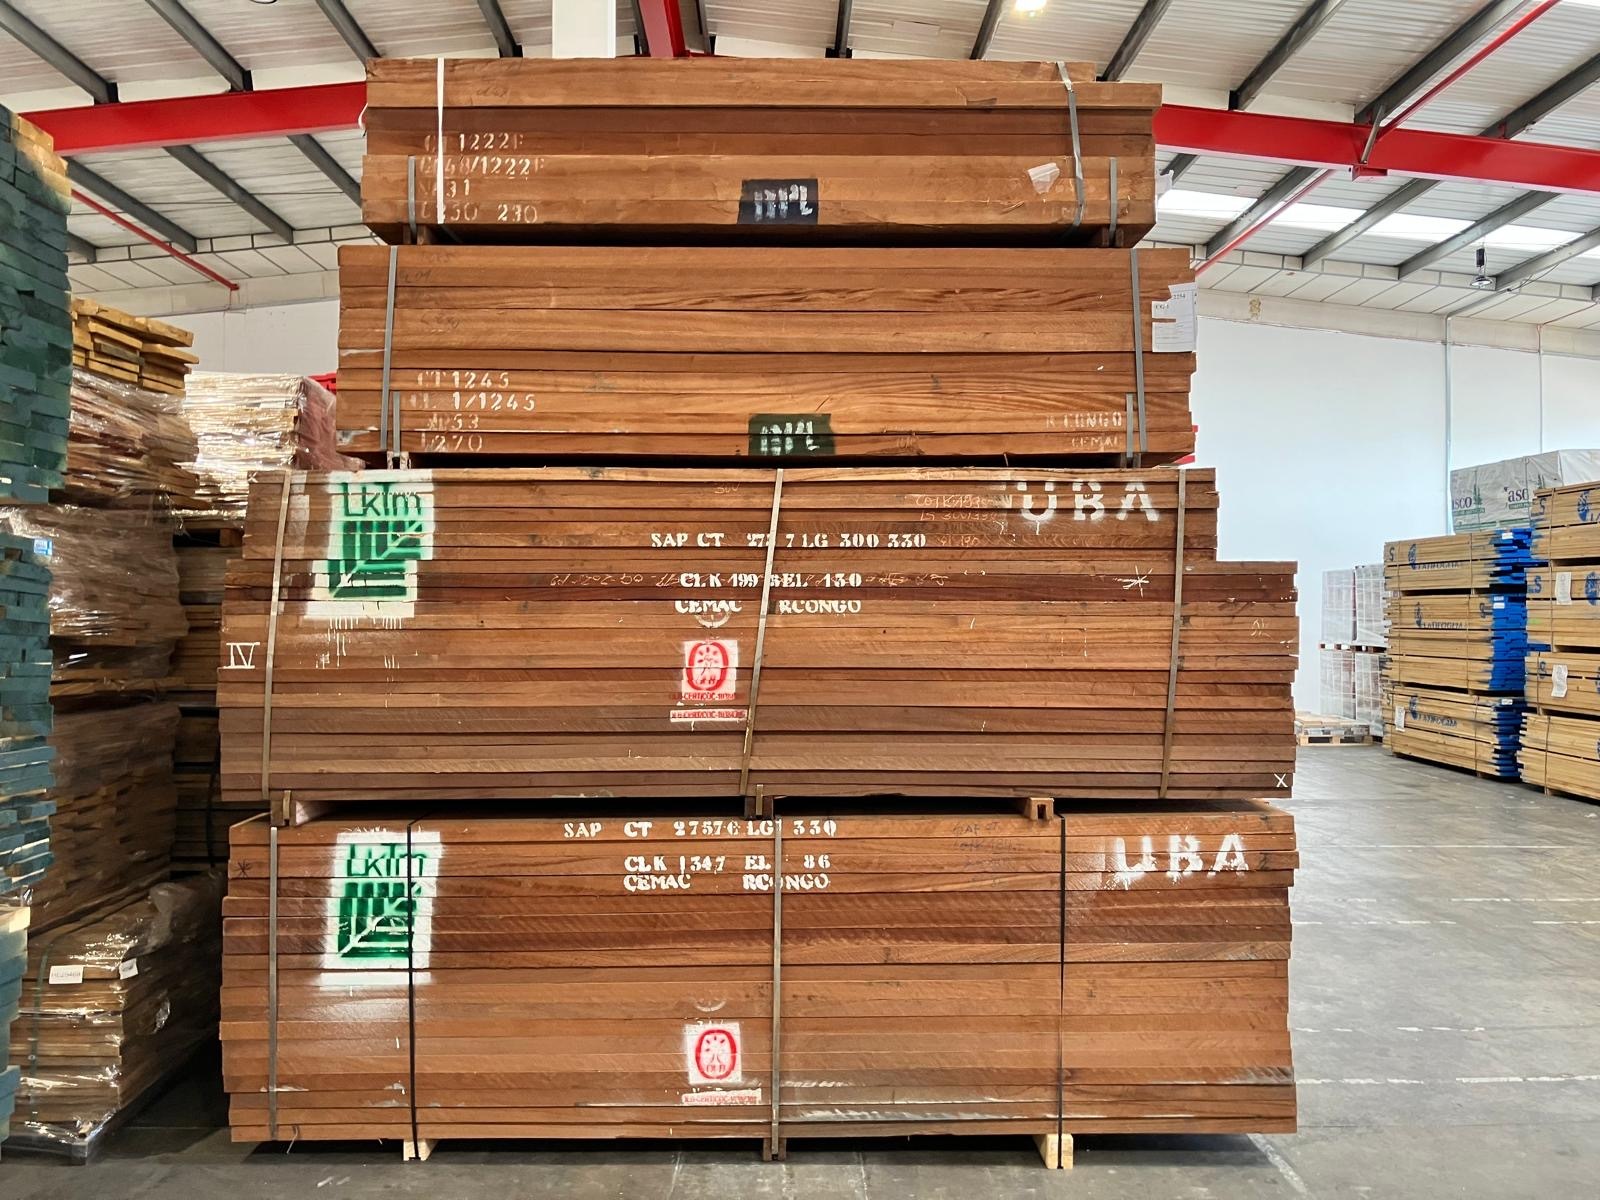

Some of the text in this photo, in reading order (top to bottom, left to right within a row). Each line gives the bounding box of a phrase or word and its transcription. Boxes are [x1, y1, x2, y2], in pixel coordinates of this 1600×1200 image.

[1016, 480, 1160, 522] UBA
[651, 533, 689, 548] SAP
[697, 533, 724, 548] CT
[801, 533, 829, 548] LG
[840, 533, 879, 548] 300
[887, 533, 926, 548] 330
[680, 573, 723, 588] CLK
[674, 599, 862, 614] CEMAC RCONGO
[563, 822, 602, 838] SAP
[623, 821, 653, 838] CT
[793, 819, 837, 837] 330
[623, 855, 668, 873] CLK
[744, 855, 772, 870] EL
[803, 854, 831, 869] 86
[1115, 833, 1250, 879] UBA
[623, 874, 692, 892] CEMAC
